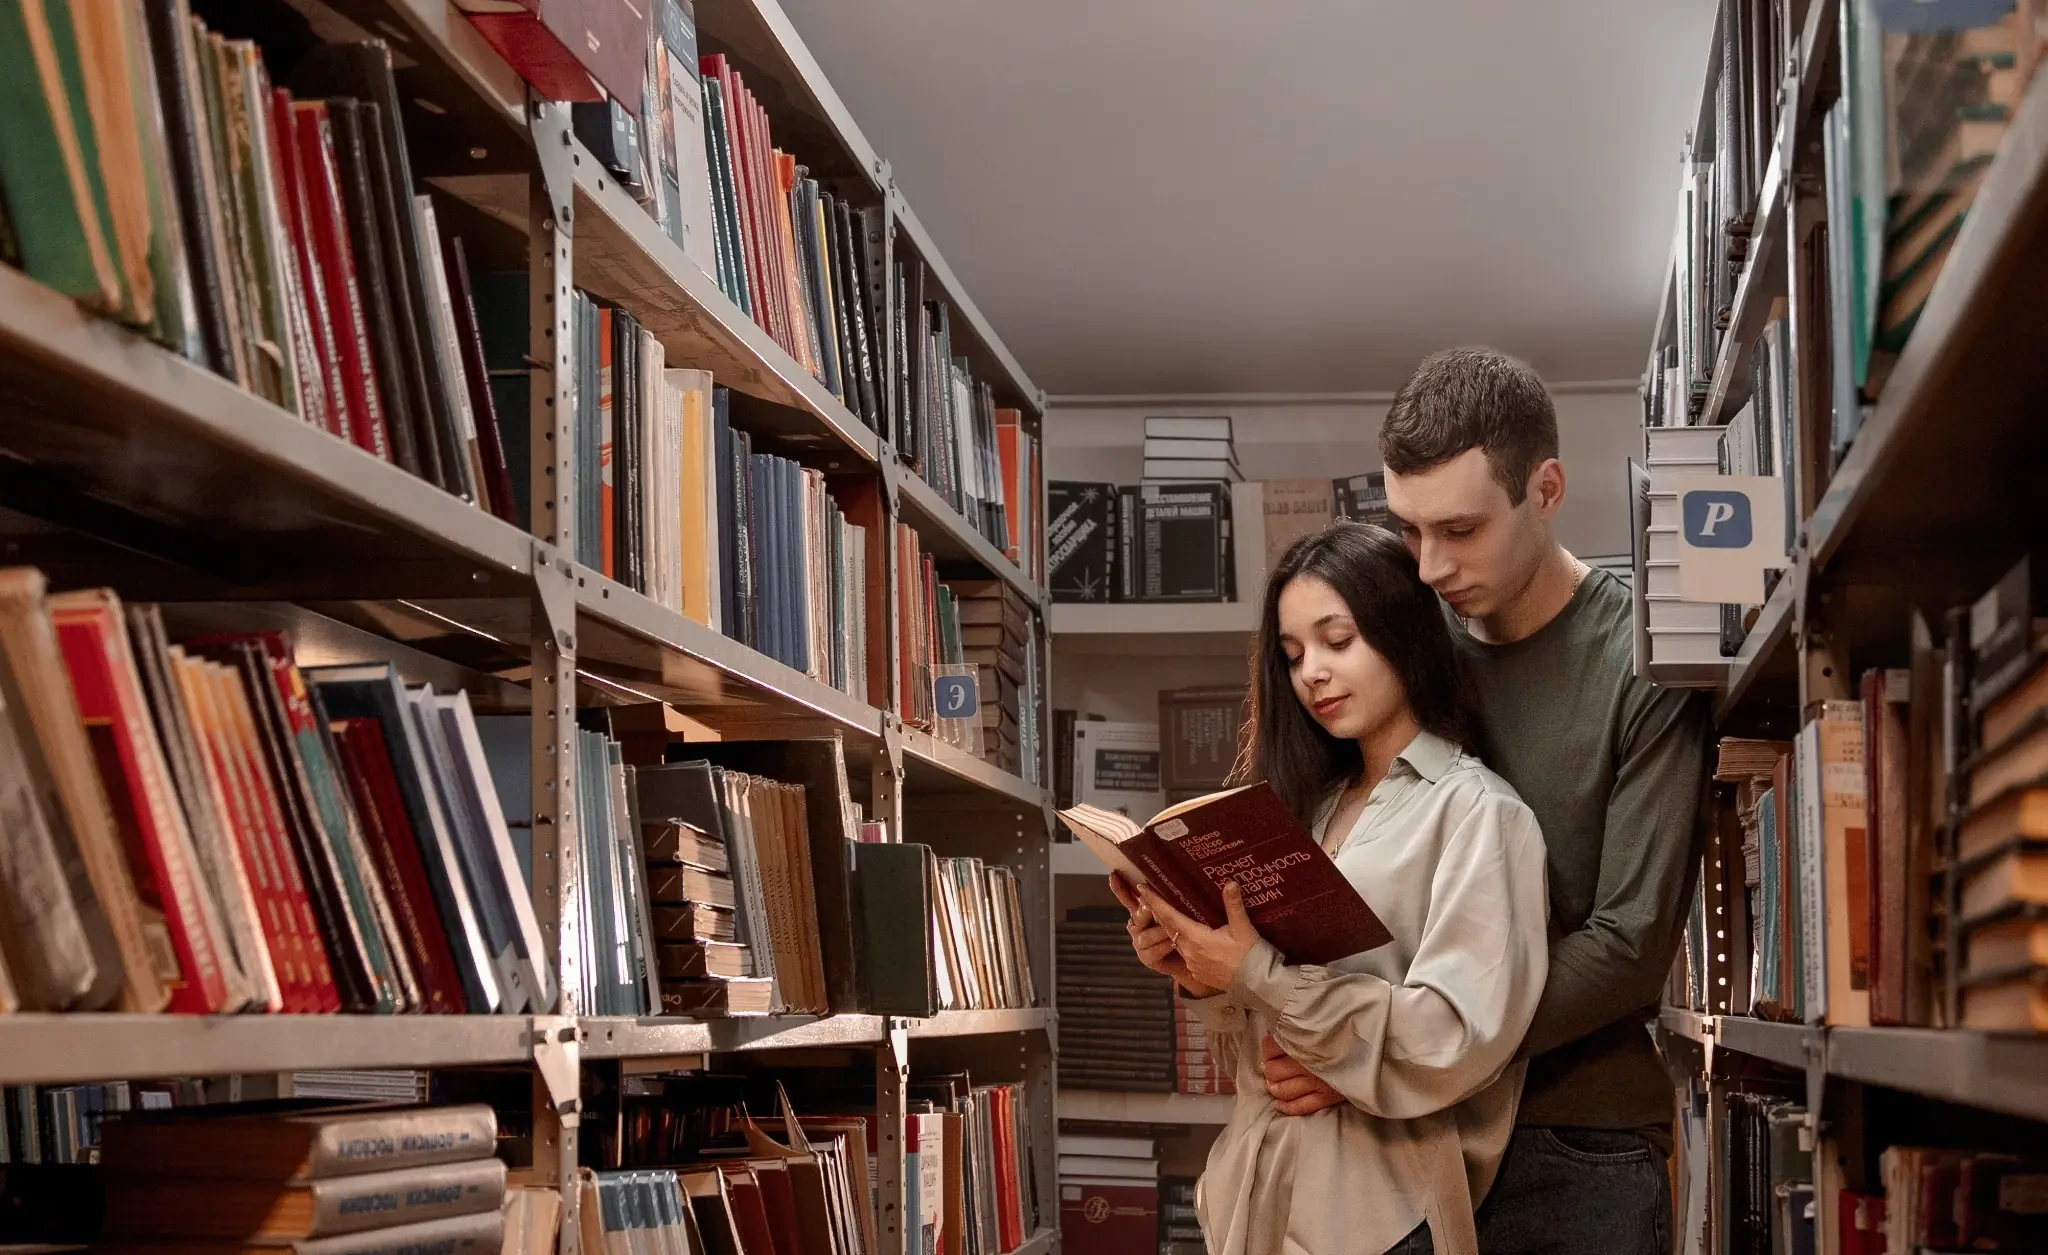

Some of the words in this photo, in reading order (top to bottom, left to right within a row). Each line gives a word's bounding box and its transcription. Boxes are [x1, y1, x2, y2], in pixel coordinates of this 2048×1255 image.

[854, 296, 872, 382] СВАРКА
[1699, 501, 1734, 537] Р
[948, 684, 965, 711] Э
[1202, 853, 1256, 880] Расчет
[1232, 851, 1311, 886] прочность
[1240, 872, 1285, 897] талей
[1245, 888, 1284, 908] ашин
